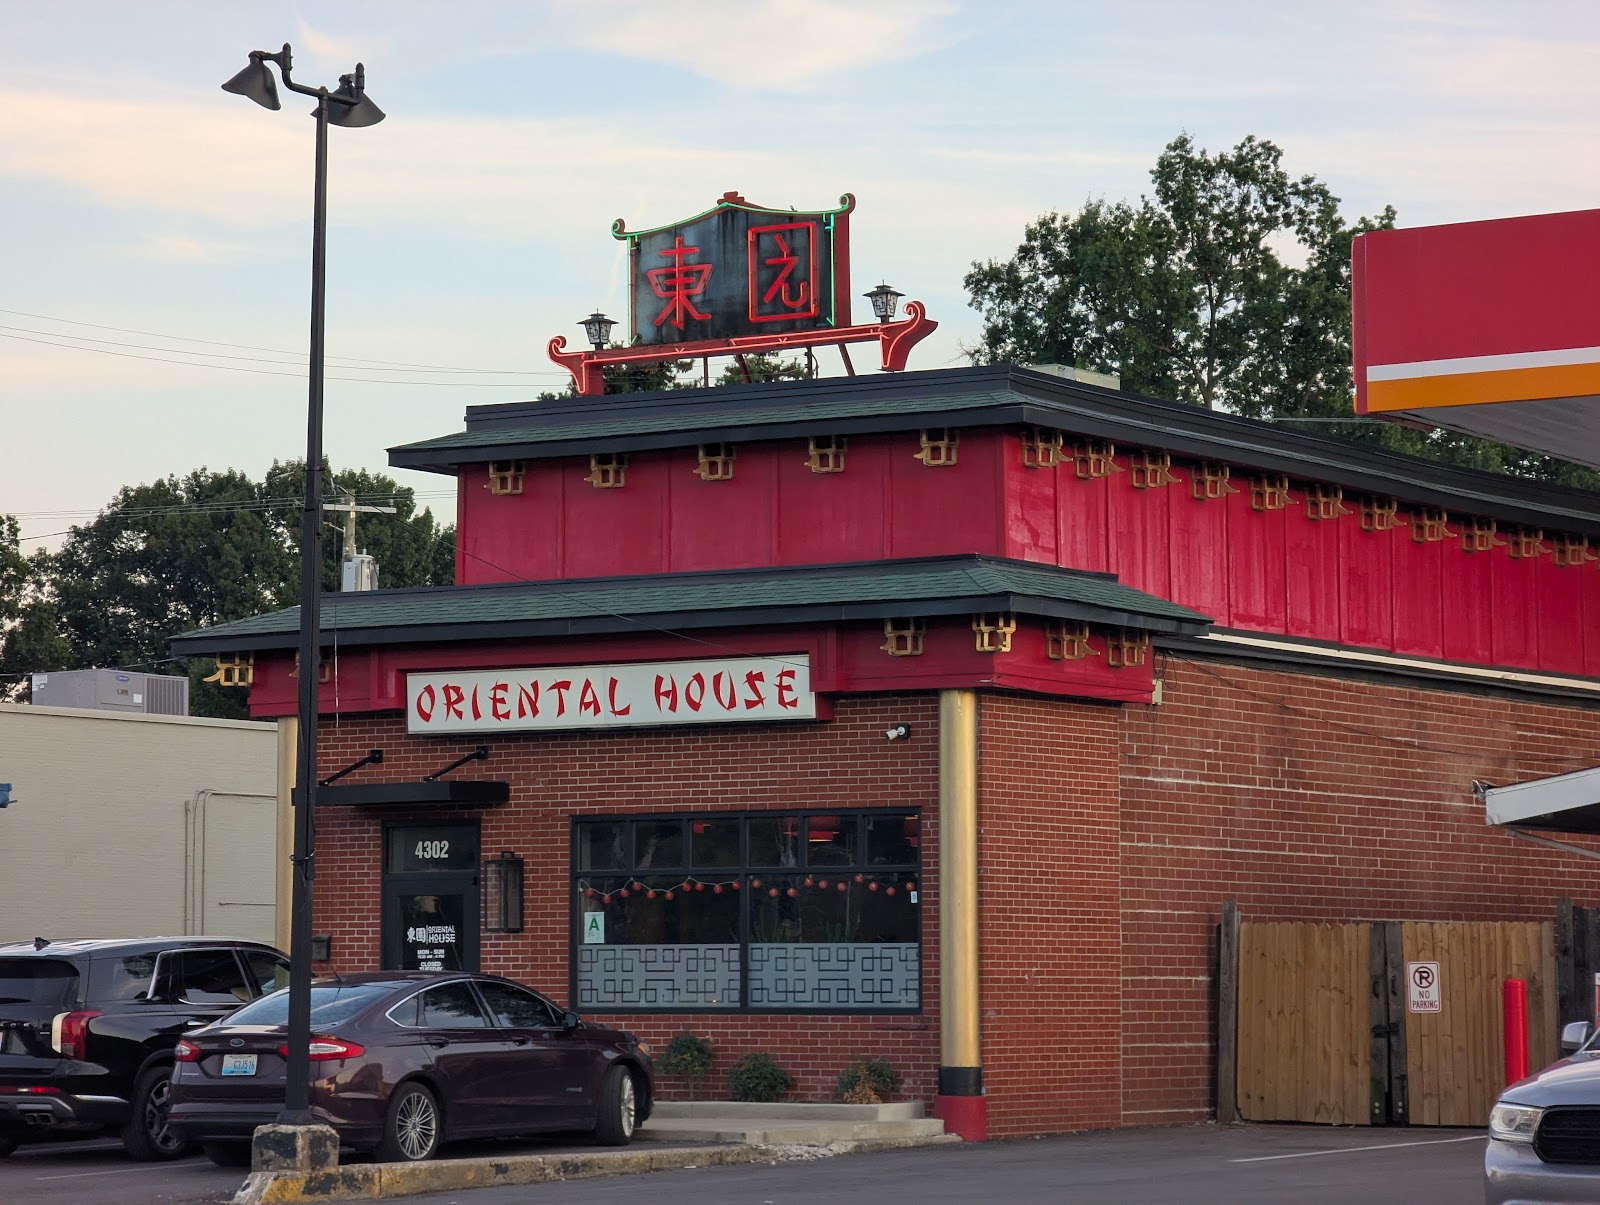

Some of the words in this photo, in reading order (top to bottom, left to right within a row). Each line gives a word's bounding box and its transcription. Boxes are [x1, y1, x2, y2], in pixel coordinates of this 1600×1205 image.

[416, 676, 631, 723] ORIENTAL
[654, 665, 799, 714] HOUSE
[415, 841, 449, 858] 4302
[589, 917, 599, 931] A
[428, 925, 455, 933] ORIENTAL
[428, 934, 456, 943] HOUSE
[1419, 990, 1431, 999] NO
[1412, 1000, 1438, 1009] PARKING
